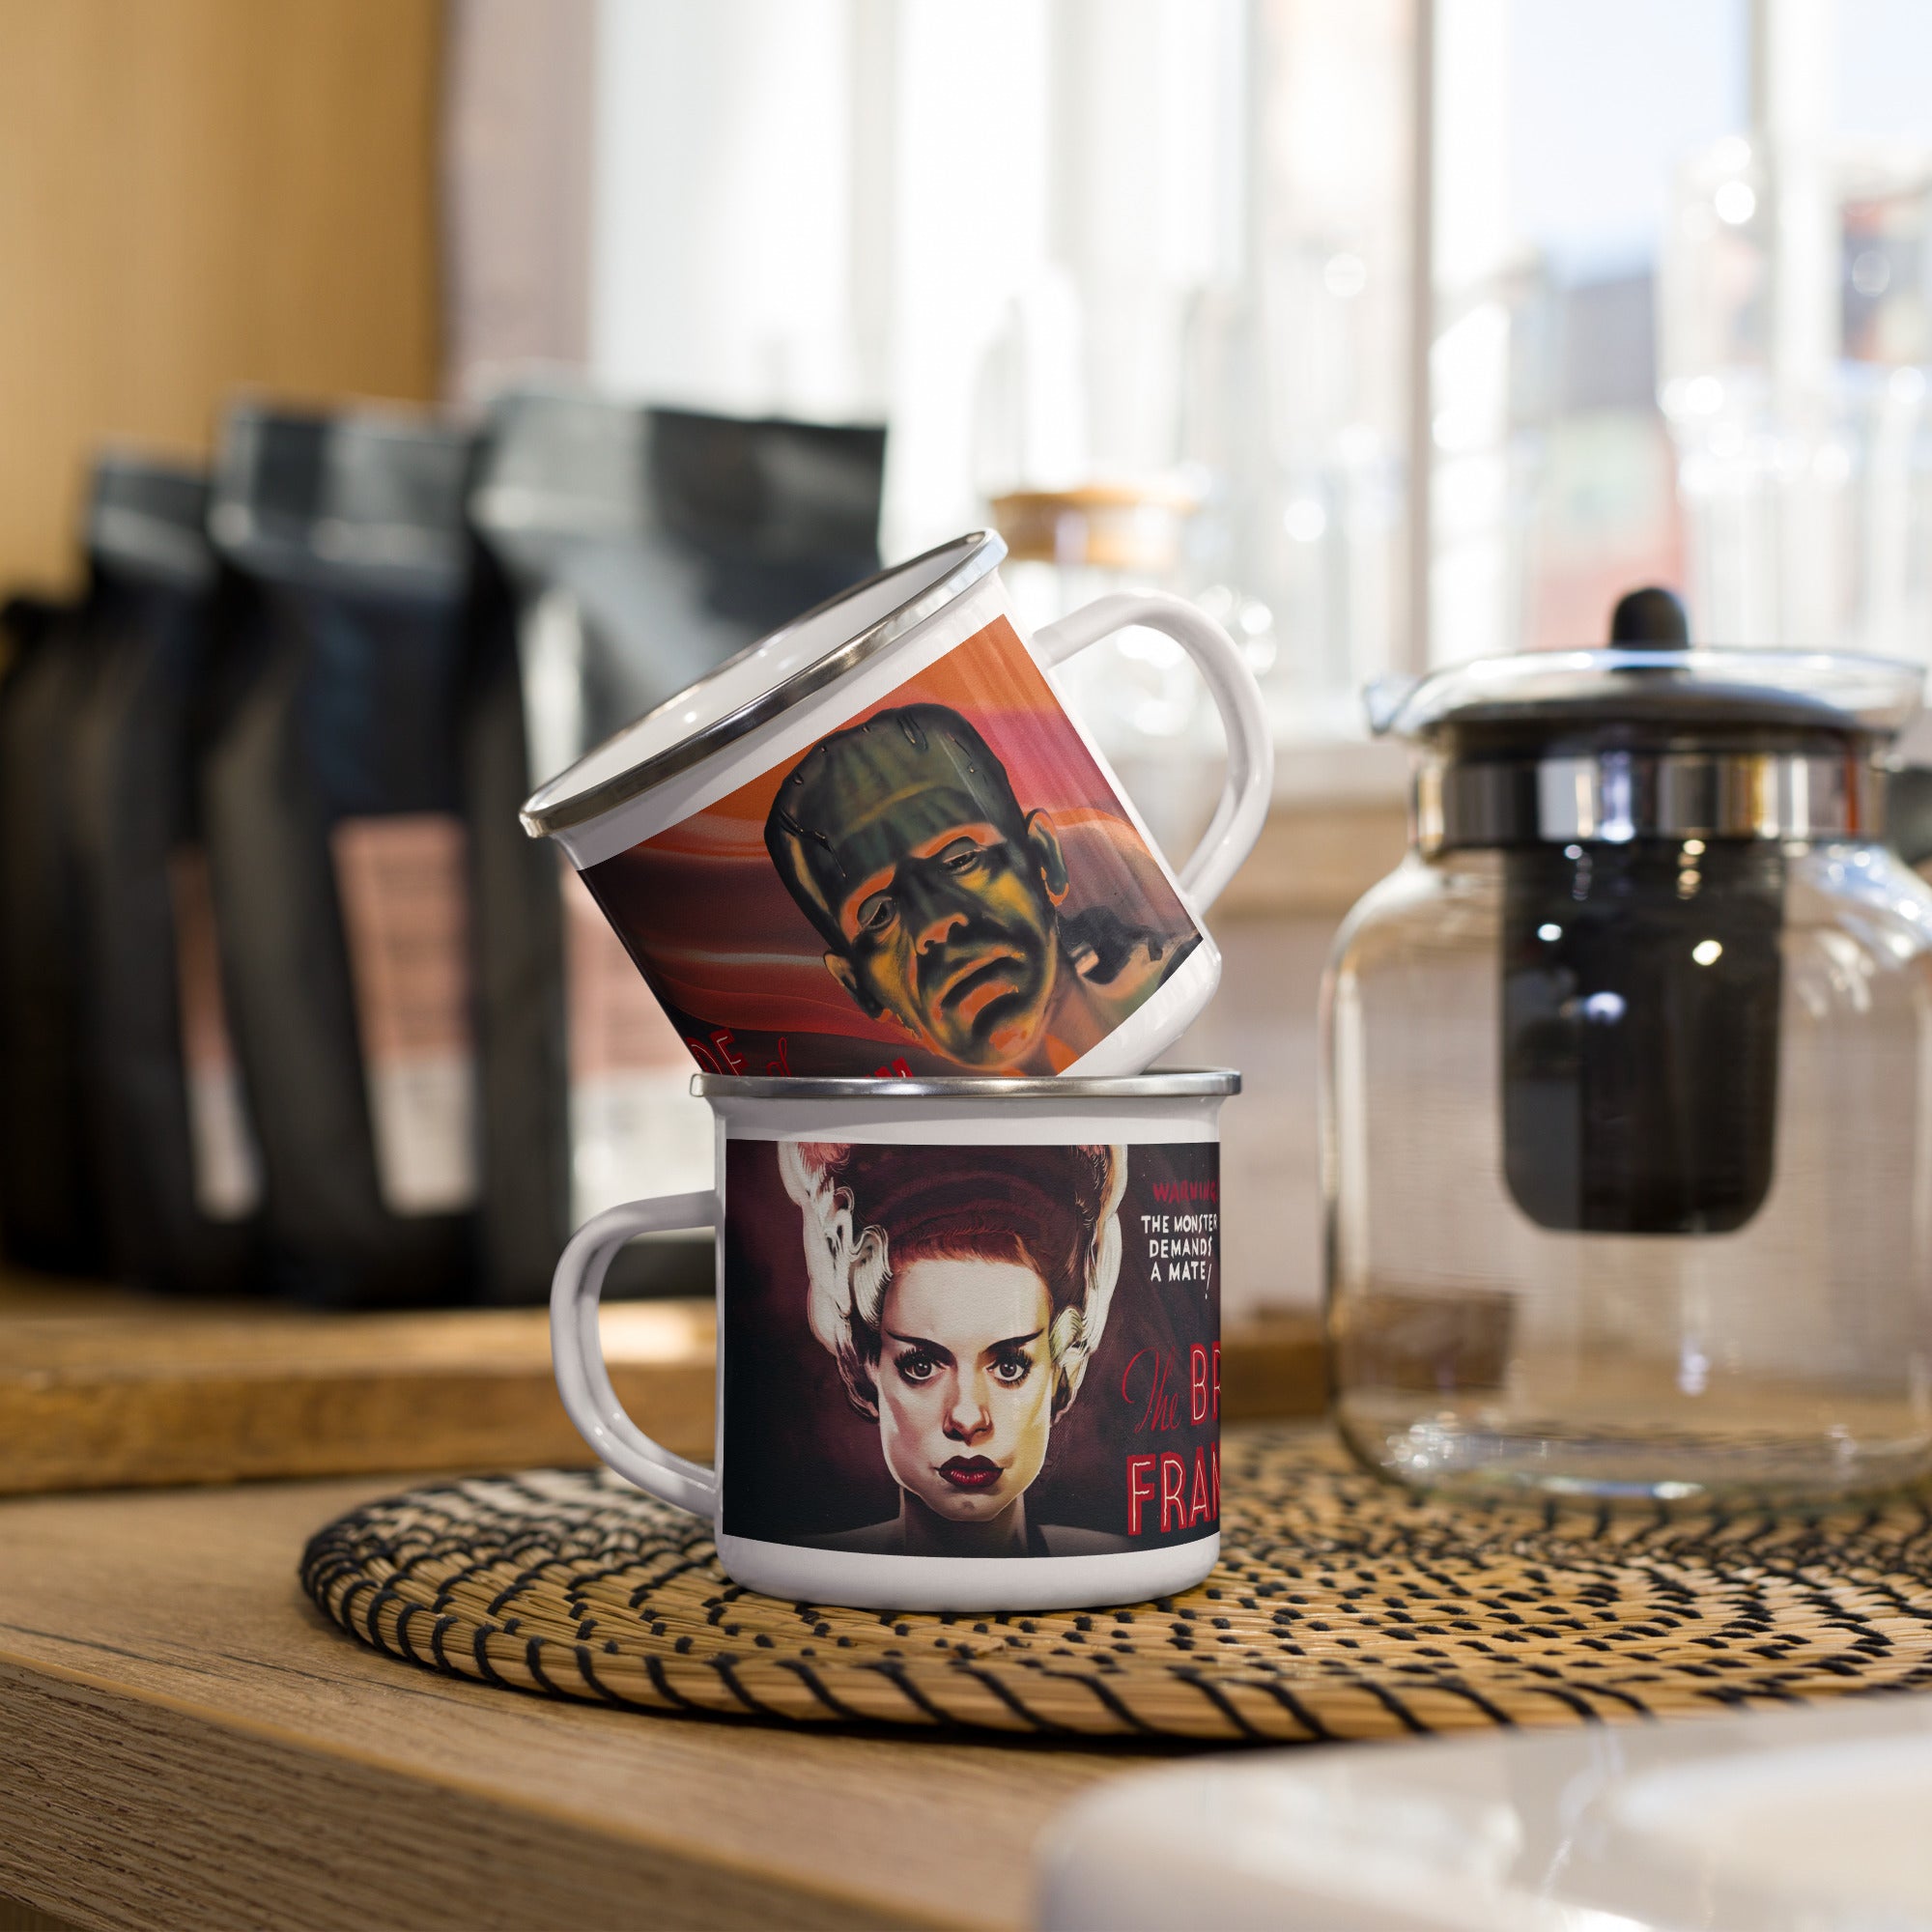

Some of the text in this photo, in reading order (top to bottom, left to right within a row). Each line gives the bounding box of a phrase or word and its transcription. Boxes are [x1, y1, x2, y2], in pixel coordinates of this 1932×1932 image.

[1141, 1213, 1218, 1235] THE MONSTER
[1149, 1236, 1213, 1259] DEMANDS
[1151, 1261, 1212, 1300] A MATE!
[1122, 1345, 1182, 1435] The
